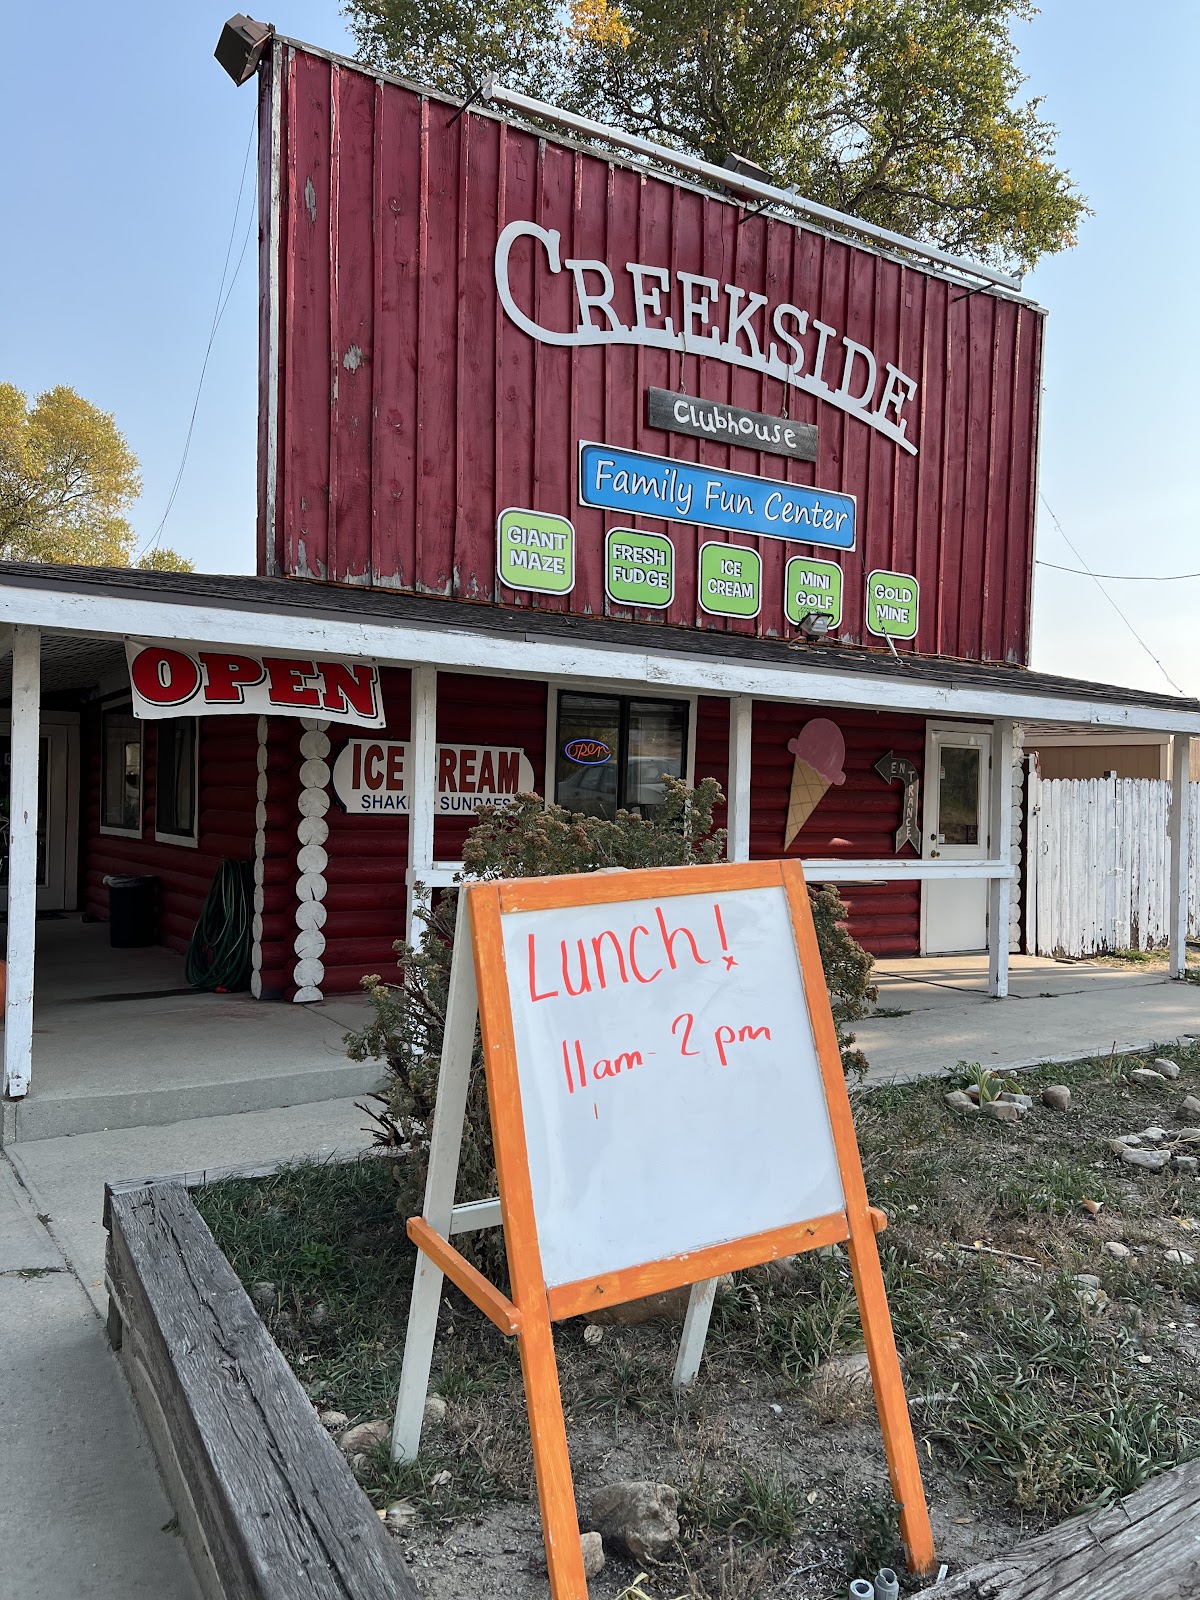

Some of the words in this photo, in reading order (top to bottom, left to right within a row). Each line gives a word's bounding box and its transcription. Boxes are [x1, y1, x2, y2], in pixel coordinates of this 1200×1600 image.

[494, 219, 919, 457] CREEKSIDE
[672, 399, 797, 449] Clubhouse
[595, 459, 694, 516] Family
[705, 481, 754, 515] Fun
[764, 491, 849, 533] Center
[507, 525, 568, 551] GIANT
[510, 549, 566, 575] MAZE
[612, 543, 666, 567] FRESH
[612, 566, 669, 589] FUDGE
[720, 559, 743, 578] ICE
[800, 571, 831, 590] MINI
[707, 578, 755, 600] CREAM
[795, 590, 834, 610] GOLF
[874, 584, 913, 604] GOLD
[876, 603, 910, 624] MINE
[131, 646, 380, 718] OPEN
[352, 743, 405, 790] ICE
[434, 748, 520, 794] REAM
[361, 794, 411, 810] SHAK
[890, 761, 916, 838] ENTRANCE
[528, 904, 739, 1002] Lunch!
[671, 1013, 701, 1056] 2
[714, 1024, 772, 1066] pm
